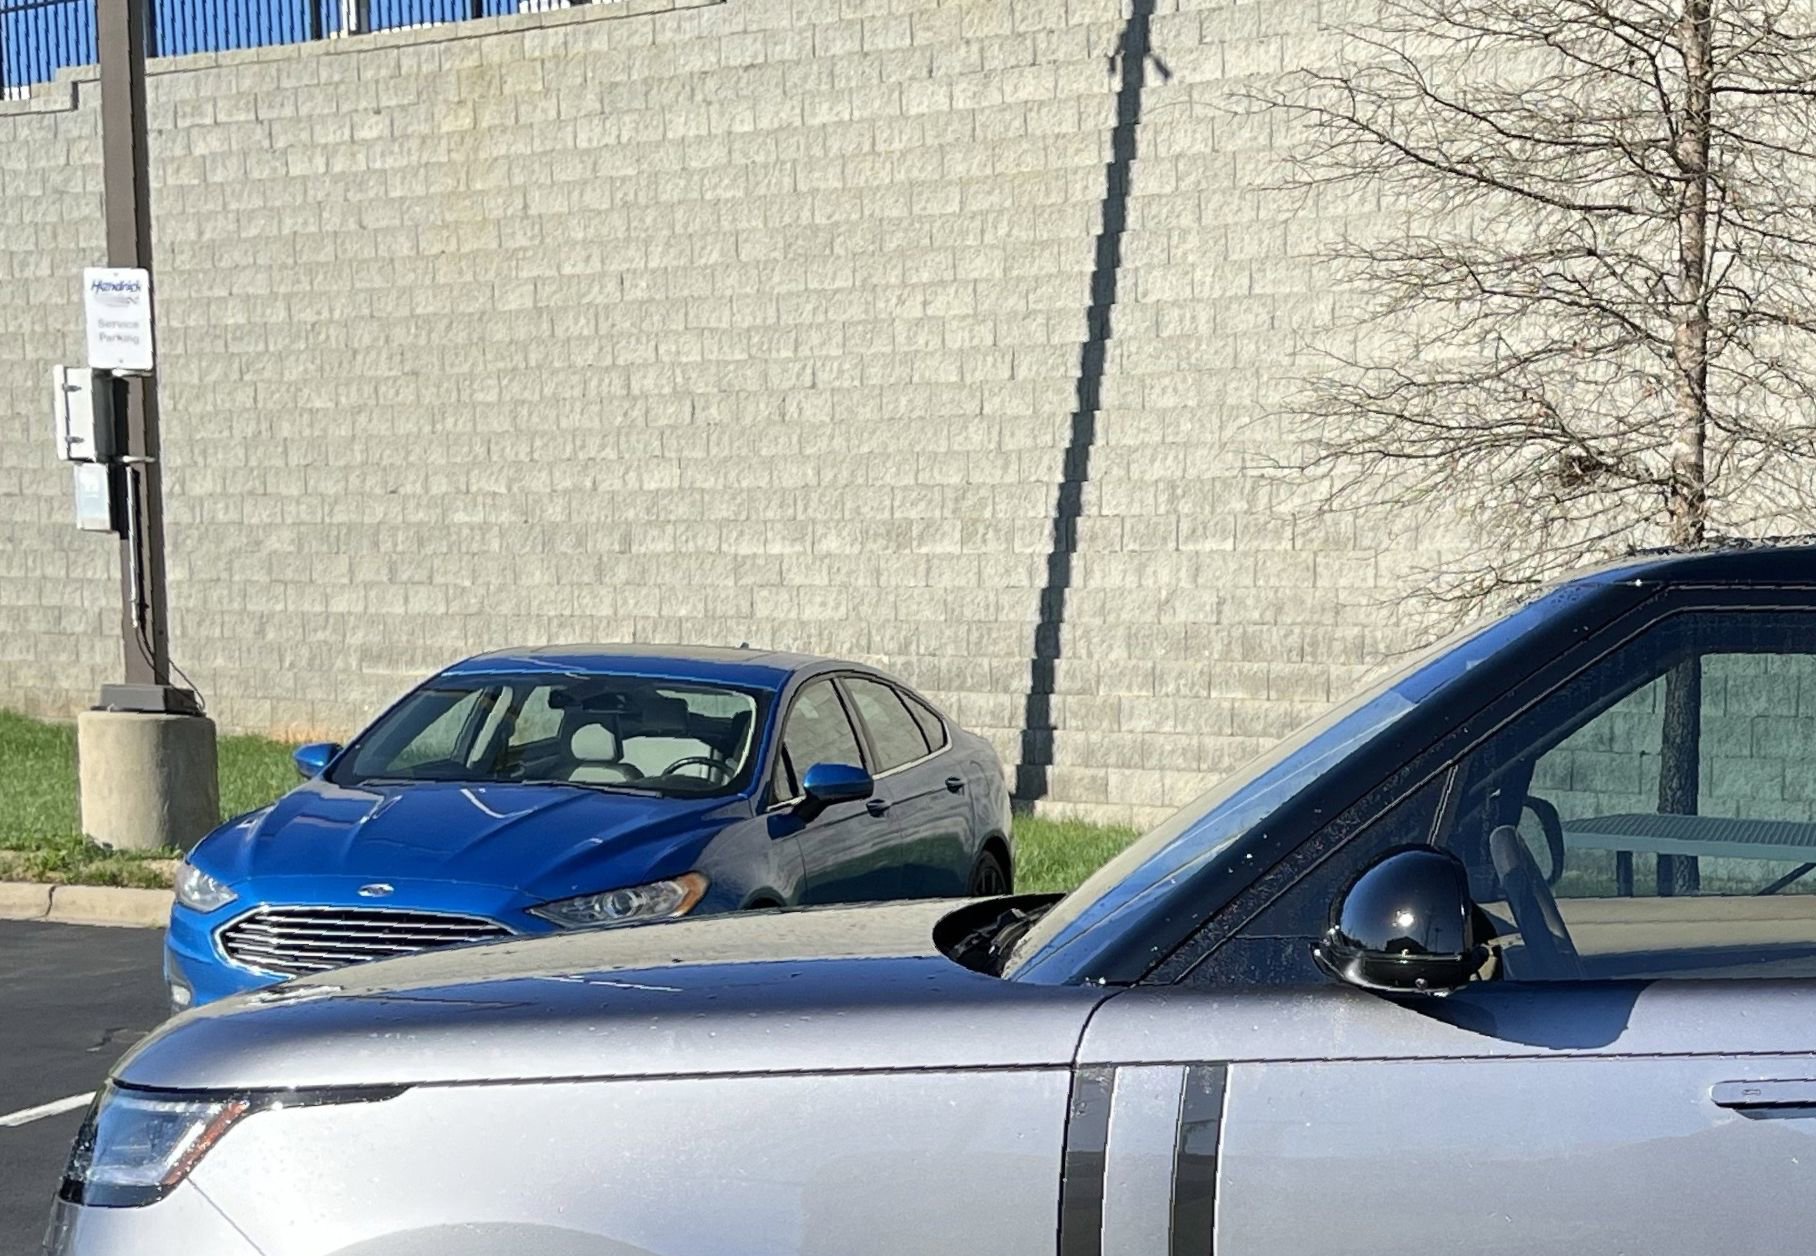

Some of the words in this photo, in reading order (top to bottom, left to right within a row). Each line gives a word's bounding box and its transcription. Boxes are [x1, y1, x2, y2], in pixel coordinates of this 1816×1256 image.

[90, 279, 142, 294] Hendrick
[98, 318, 140, 329] Service
[98, 331, 140, 345] Parking
